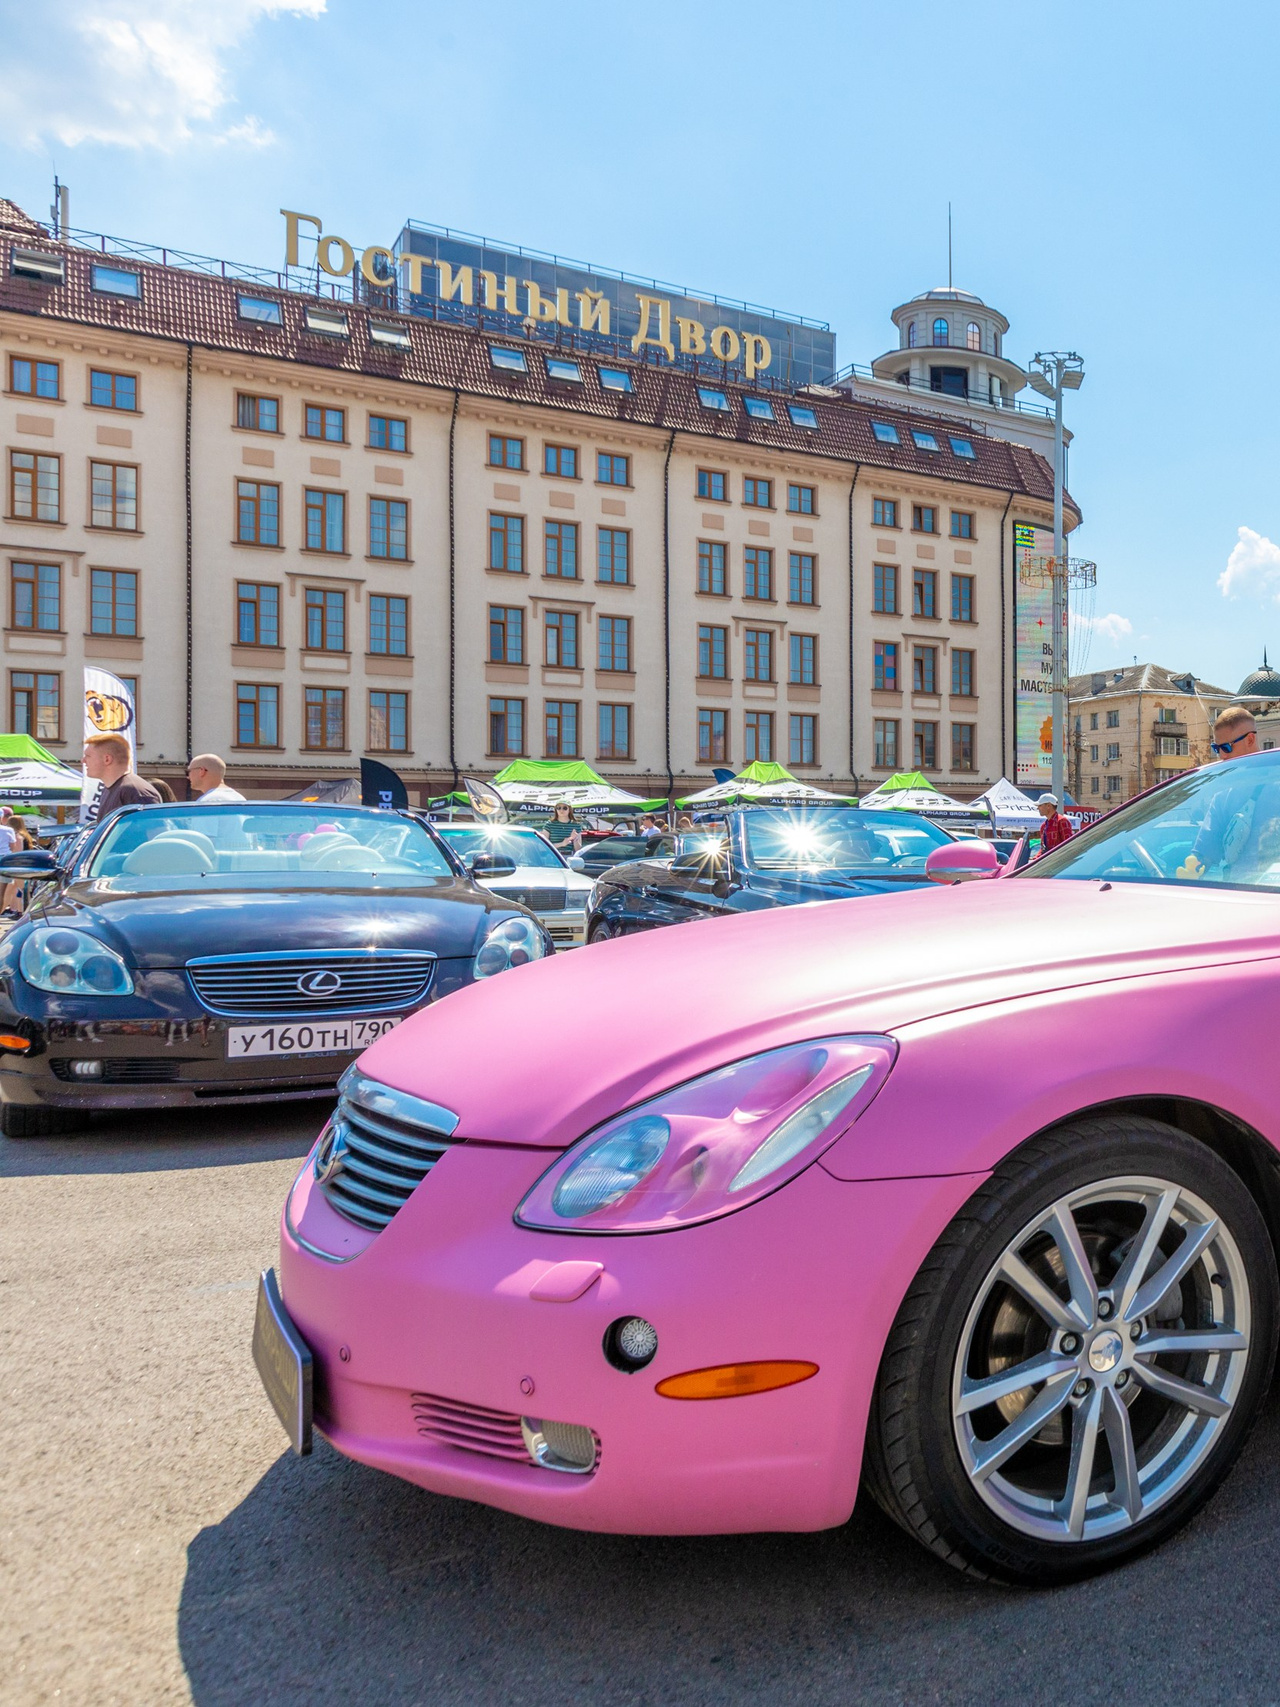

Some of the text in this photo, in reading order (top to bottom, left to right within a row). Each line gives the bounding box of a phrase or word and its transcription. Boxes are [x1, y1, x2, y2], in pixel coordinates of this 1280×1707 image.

[280, 208, 772, 379] Гостиный Двор
[520, 804, 555, 812] ALPHA
[241, 1020, 394, 1052] У160ТН 790
[298, 1051, 338, 1059] LEXUS
